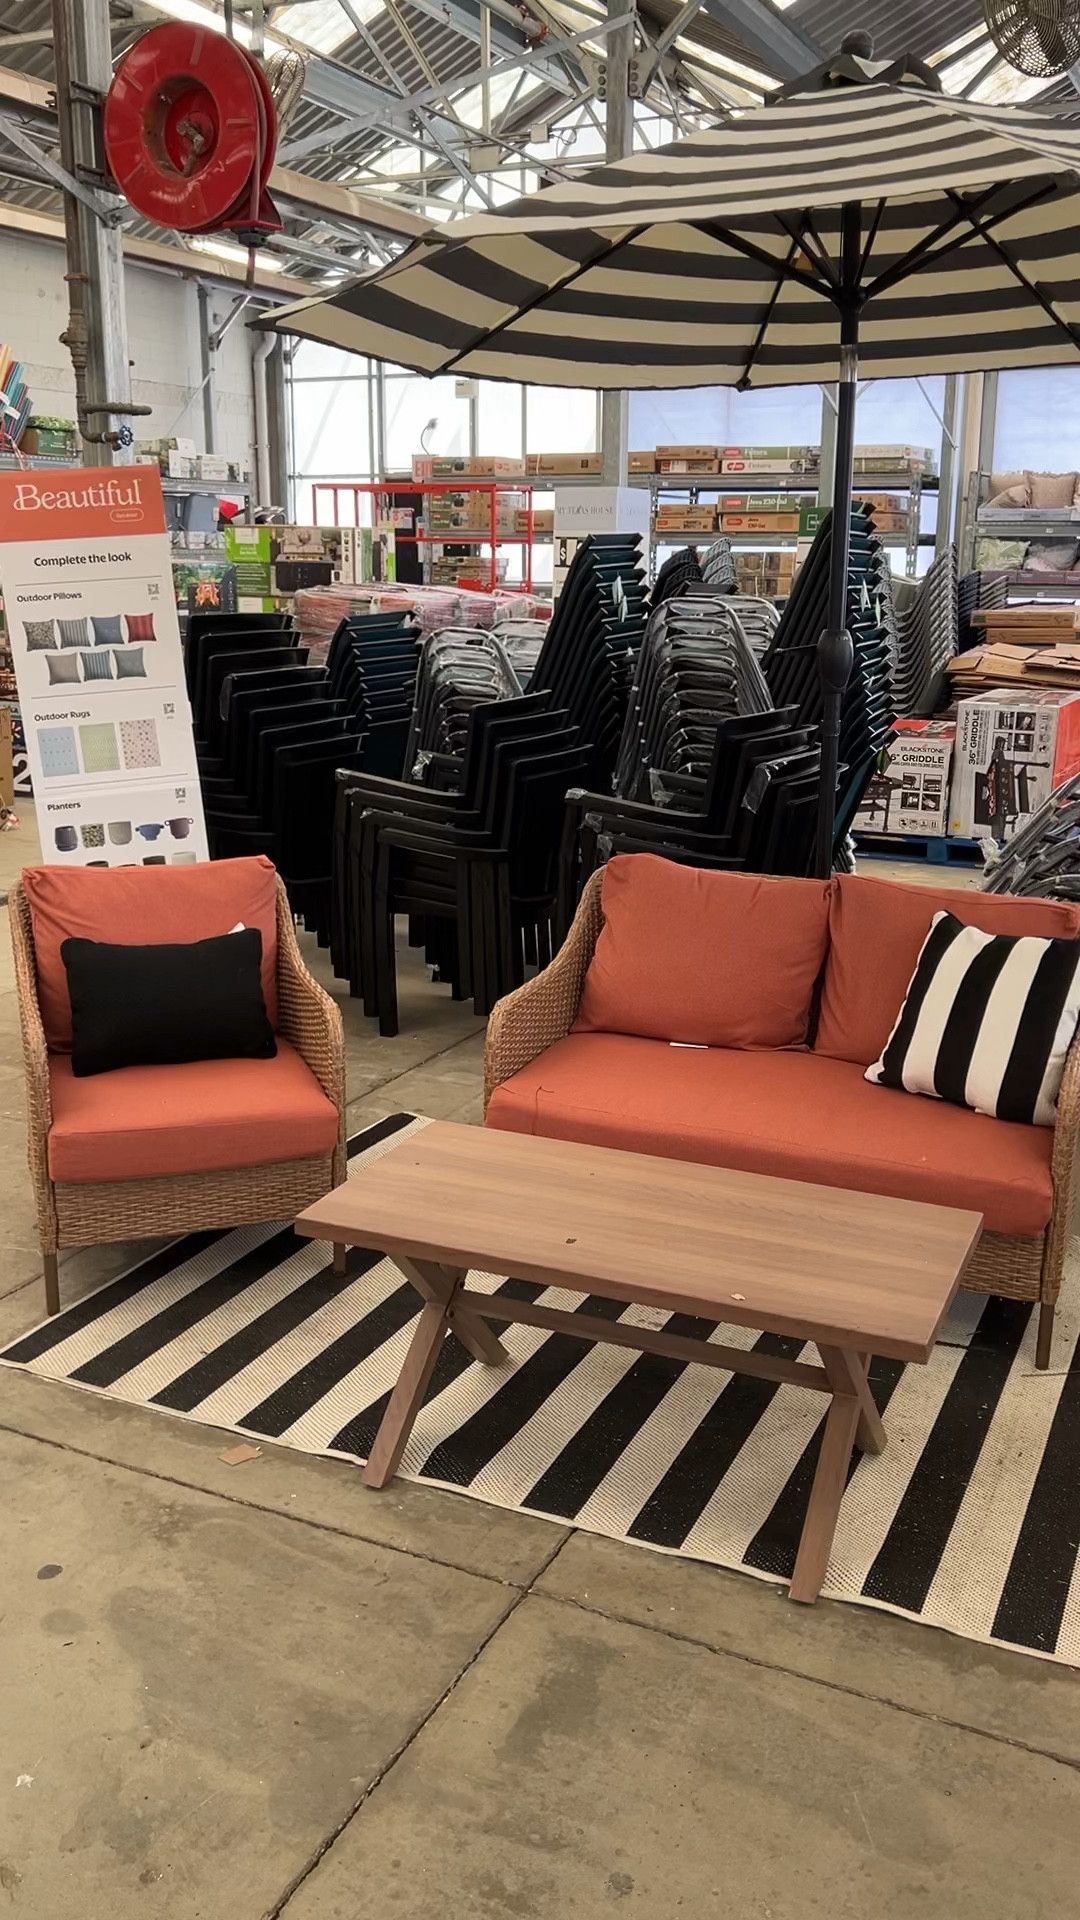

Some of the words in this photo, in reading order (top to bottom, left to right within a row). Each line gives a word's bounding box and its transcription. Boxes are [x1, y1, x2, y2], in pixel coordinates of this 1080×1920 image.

[13, 479, 142, 511] Beautiful
[34, 555, 87, 567] Complete
[88, 554, 107, 564] the
[108, 552, 133, 562] look
[16, 593, 52, 603] Outdoor
[53, 592, 82, 601] Pillows
[34, 712, 69, 722] Outdoor
[70, 710, 91, 721] Rugs
[961, 709, 970, 751] BLACKSTONE
[969, 709, 980, 748] GRIDDLE
[901, 745, 944, 754] BLACKSTONE
[902, 754, 945, 764] GRIDDLE
[47, 801, 81, 811] Planters
